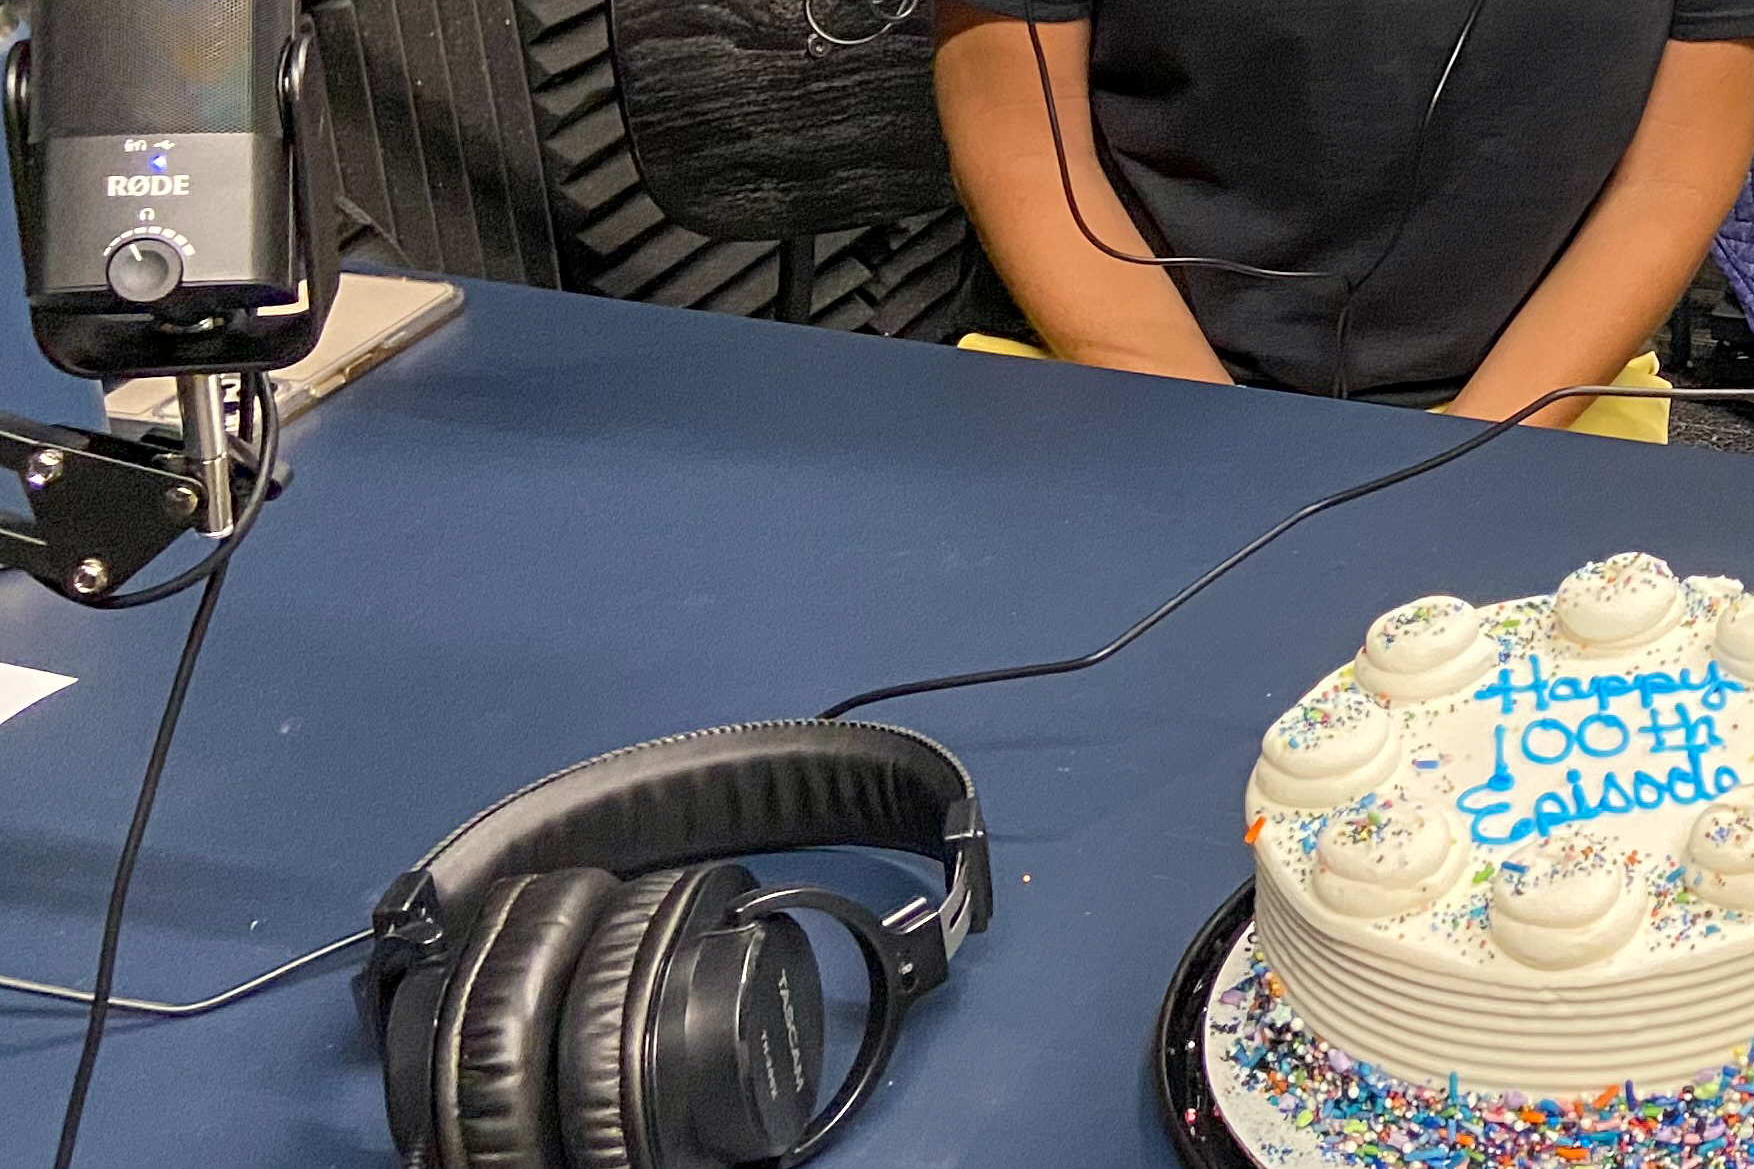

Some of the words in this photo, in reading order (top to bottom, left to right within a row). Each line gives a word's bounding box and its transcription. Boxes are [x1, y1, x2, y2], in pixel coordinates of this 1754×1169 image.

[107, 175, 190, 197] RØDE
[1474, 654, 1746, 714] Happy
[778, 968, 804, 1093] TASCAM
